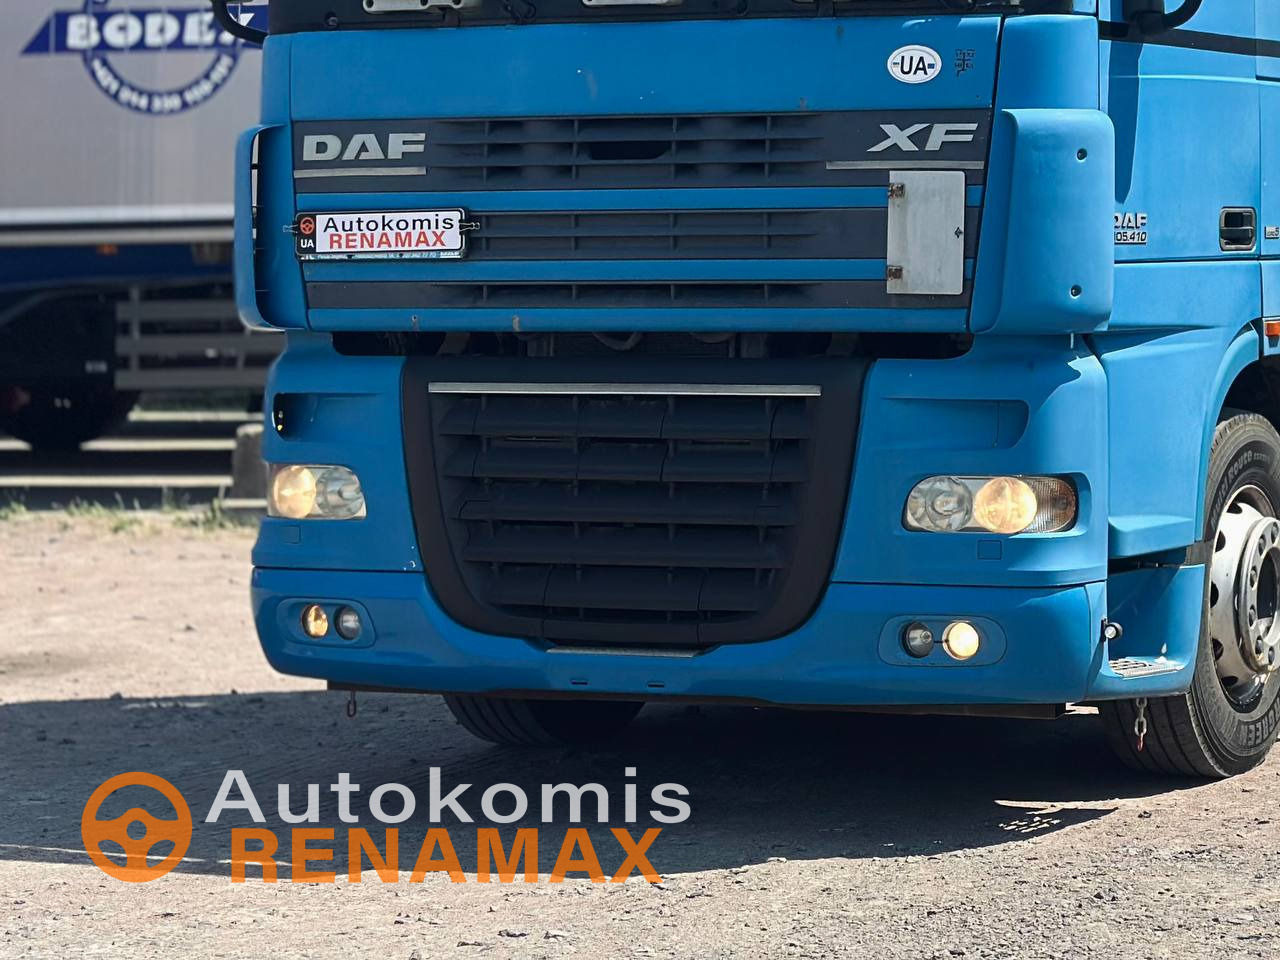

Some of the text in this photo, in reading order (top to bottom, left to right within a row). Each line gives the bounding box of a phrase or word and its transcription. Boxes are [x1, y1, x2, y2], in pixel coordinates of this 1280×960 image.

[900, 55, 929, 76] UA
[303, 133, 426, 161] DAF
[866, 123, 978, 152] XF
[323, 213, 455, 233] Autokomis
[300, 238, 314, 248] UA
[329, 230, 446, 249] RENAMAX
